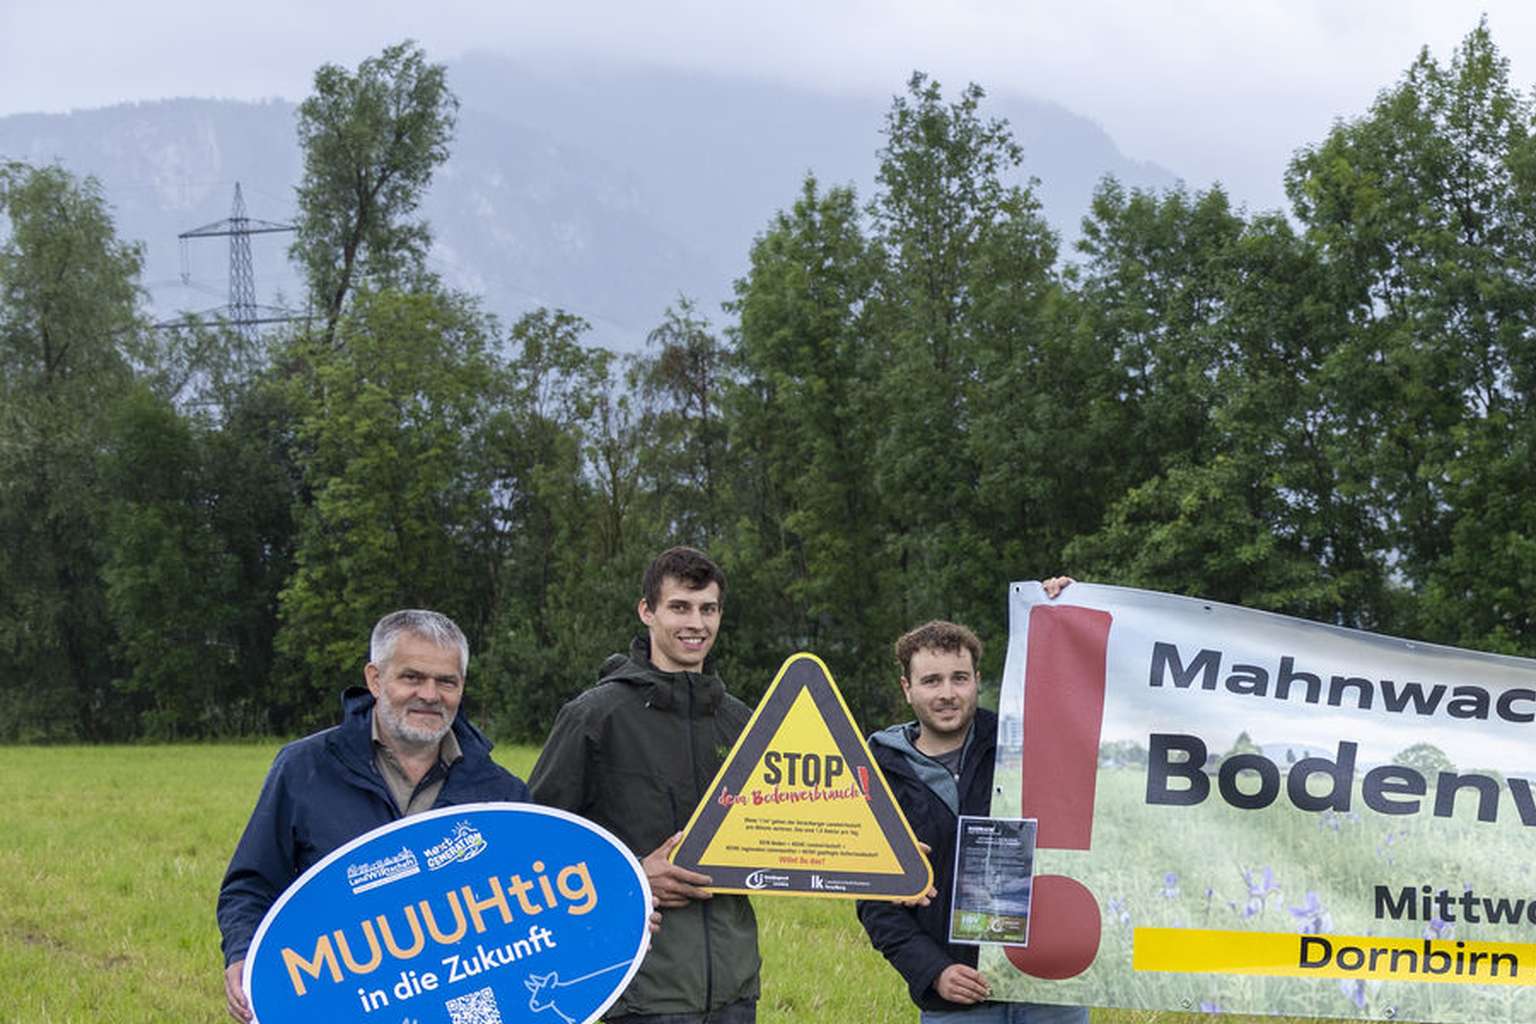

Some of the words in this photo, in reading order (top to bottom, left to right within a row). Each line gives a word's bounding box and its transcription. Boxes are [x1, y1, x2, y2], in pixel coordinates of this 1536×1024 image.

[764, 751, 844, 787] STOP
[281, 861, 598, 997] MUUUHtig
[1300, 936, 1518, 978] Dornbirn
[359, 987, 389, 1013] in
[394, 969, 438, 1001] die
[443, 926, 557, 984] Zukunft
